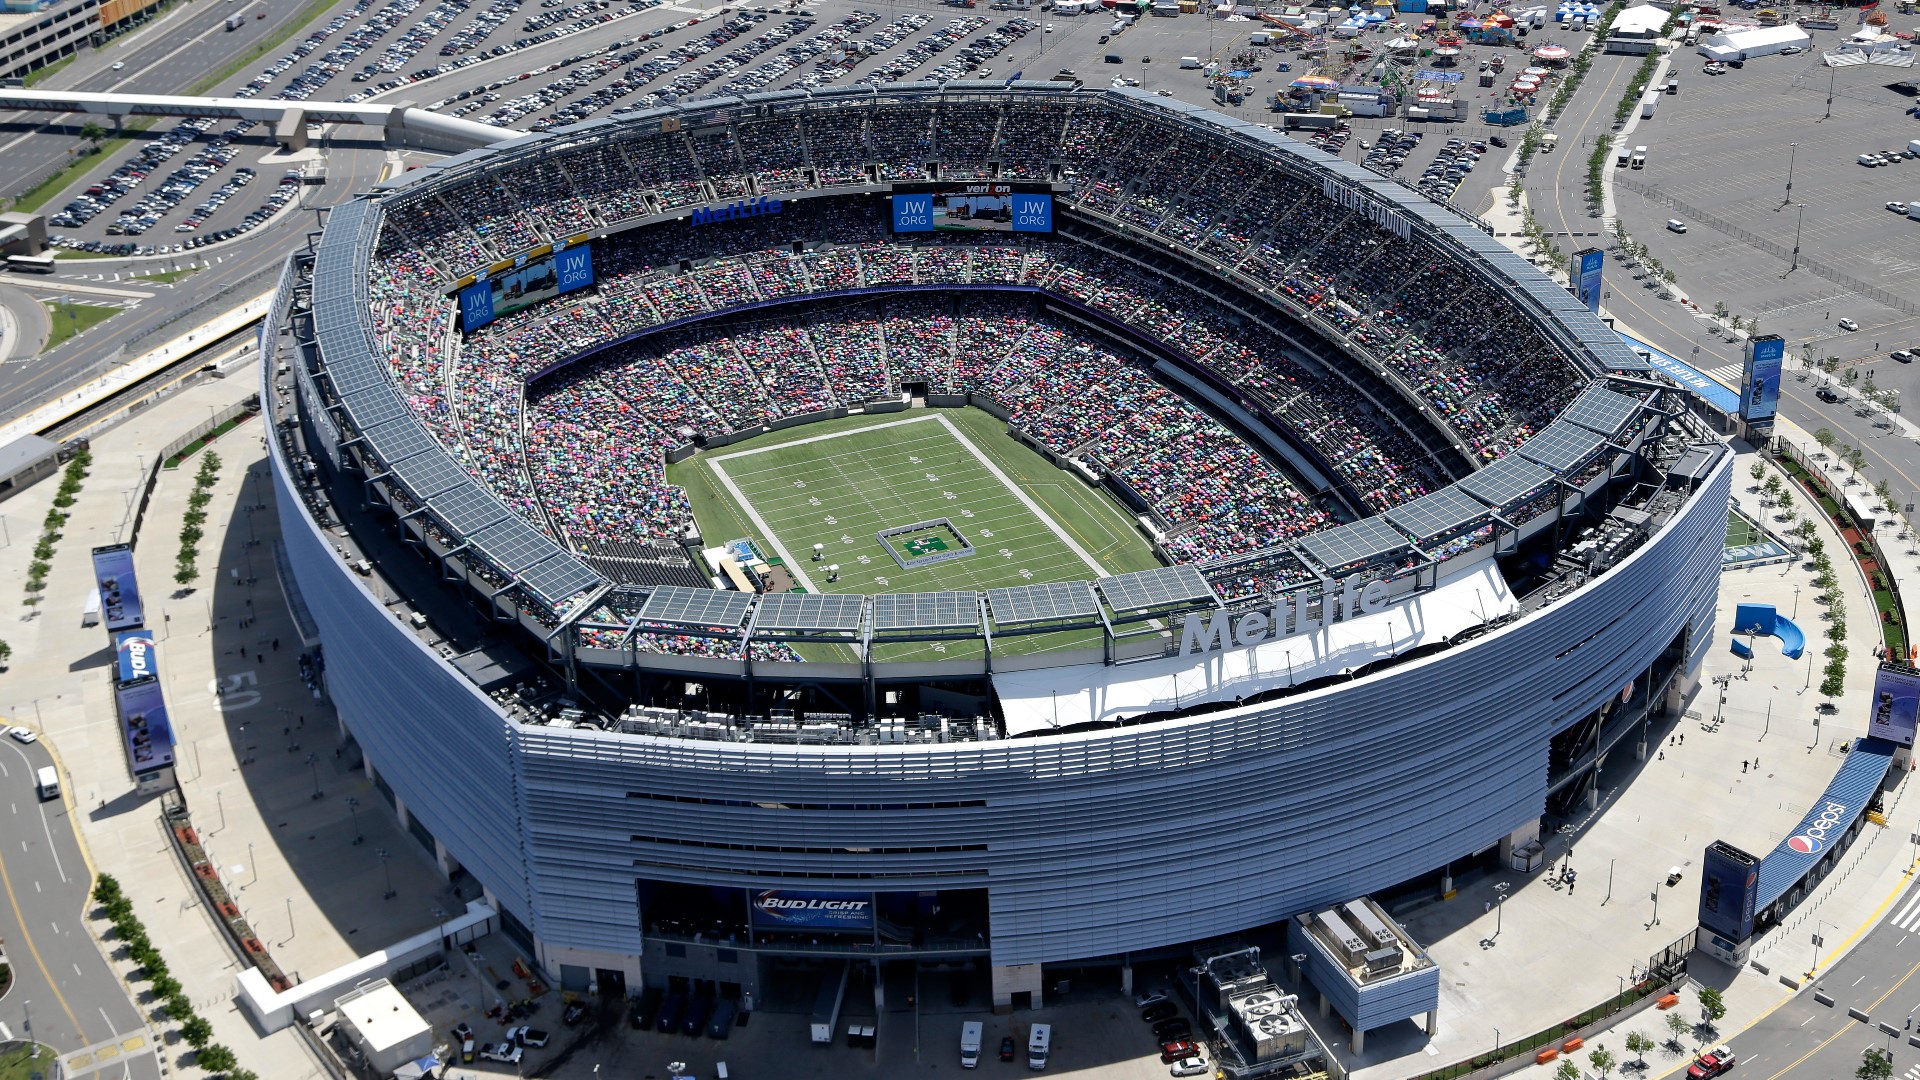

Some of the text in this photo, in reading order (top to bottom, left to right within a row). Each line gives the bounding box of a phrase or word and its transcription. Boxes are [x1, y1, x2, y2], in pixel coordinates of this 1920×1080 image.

[966, 183, 1010, 194] verizon
[691, 195, 783, 227] MetLife
[900, 201, 925, 215] JW
[1020, 201, 1045, 215] JW
[1323, 178, 1411, 243] METLIFE STADIUM
[899, 216, 927, 226] .ORG
[1018, 215, 1045, 226] .ORG
[563, 253, 585, 273] JW
[562, 269, 587, 285] .ORG
[468, 290, 487, 311] JW
[467, 306, 489, 324] .ORG
[1179, 573, 1391, 658] MetLife
[129, 642, 146, 670] BUD
[1806, 801, 1847, 841] pepsi
[762, 897, 869, 910] BUD LIGHT
[1745, 891, 1753, 922] pepsi
